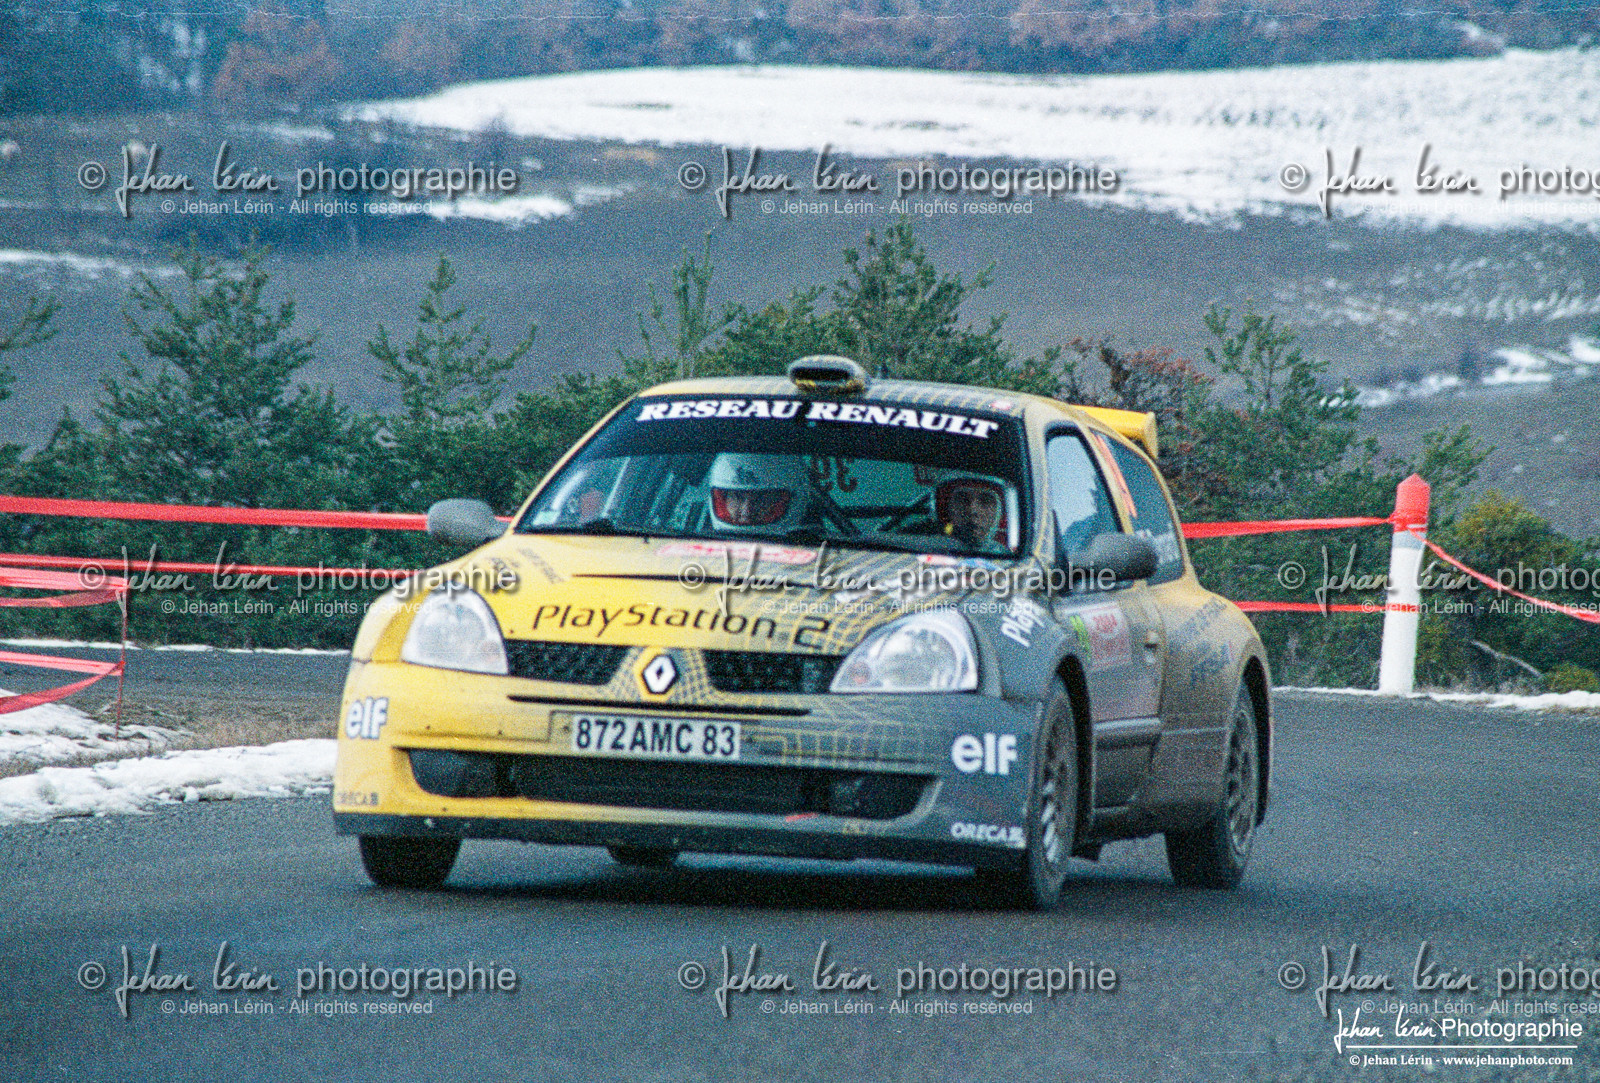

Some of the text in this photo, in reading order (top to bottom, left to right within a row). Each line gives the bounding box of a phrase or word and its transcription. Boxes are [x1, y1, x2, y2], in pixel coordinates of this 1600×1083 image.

[636, 400, 999, 439] RESEAU RENAULT
[532, 602, 832, 649] PlayStation 2
[345, 696, 389, 739] elf
[576, 719, 736, 756] 872AMC 83
[951, 733, 1018, 776] elf
